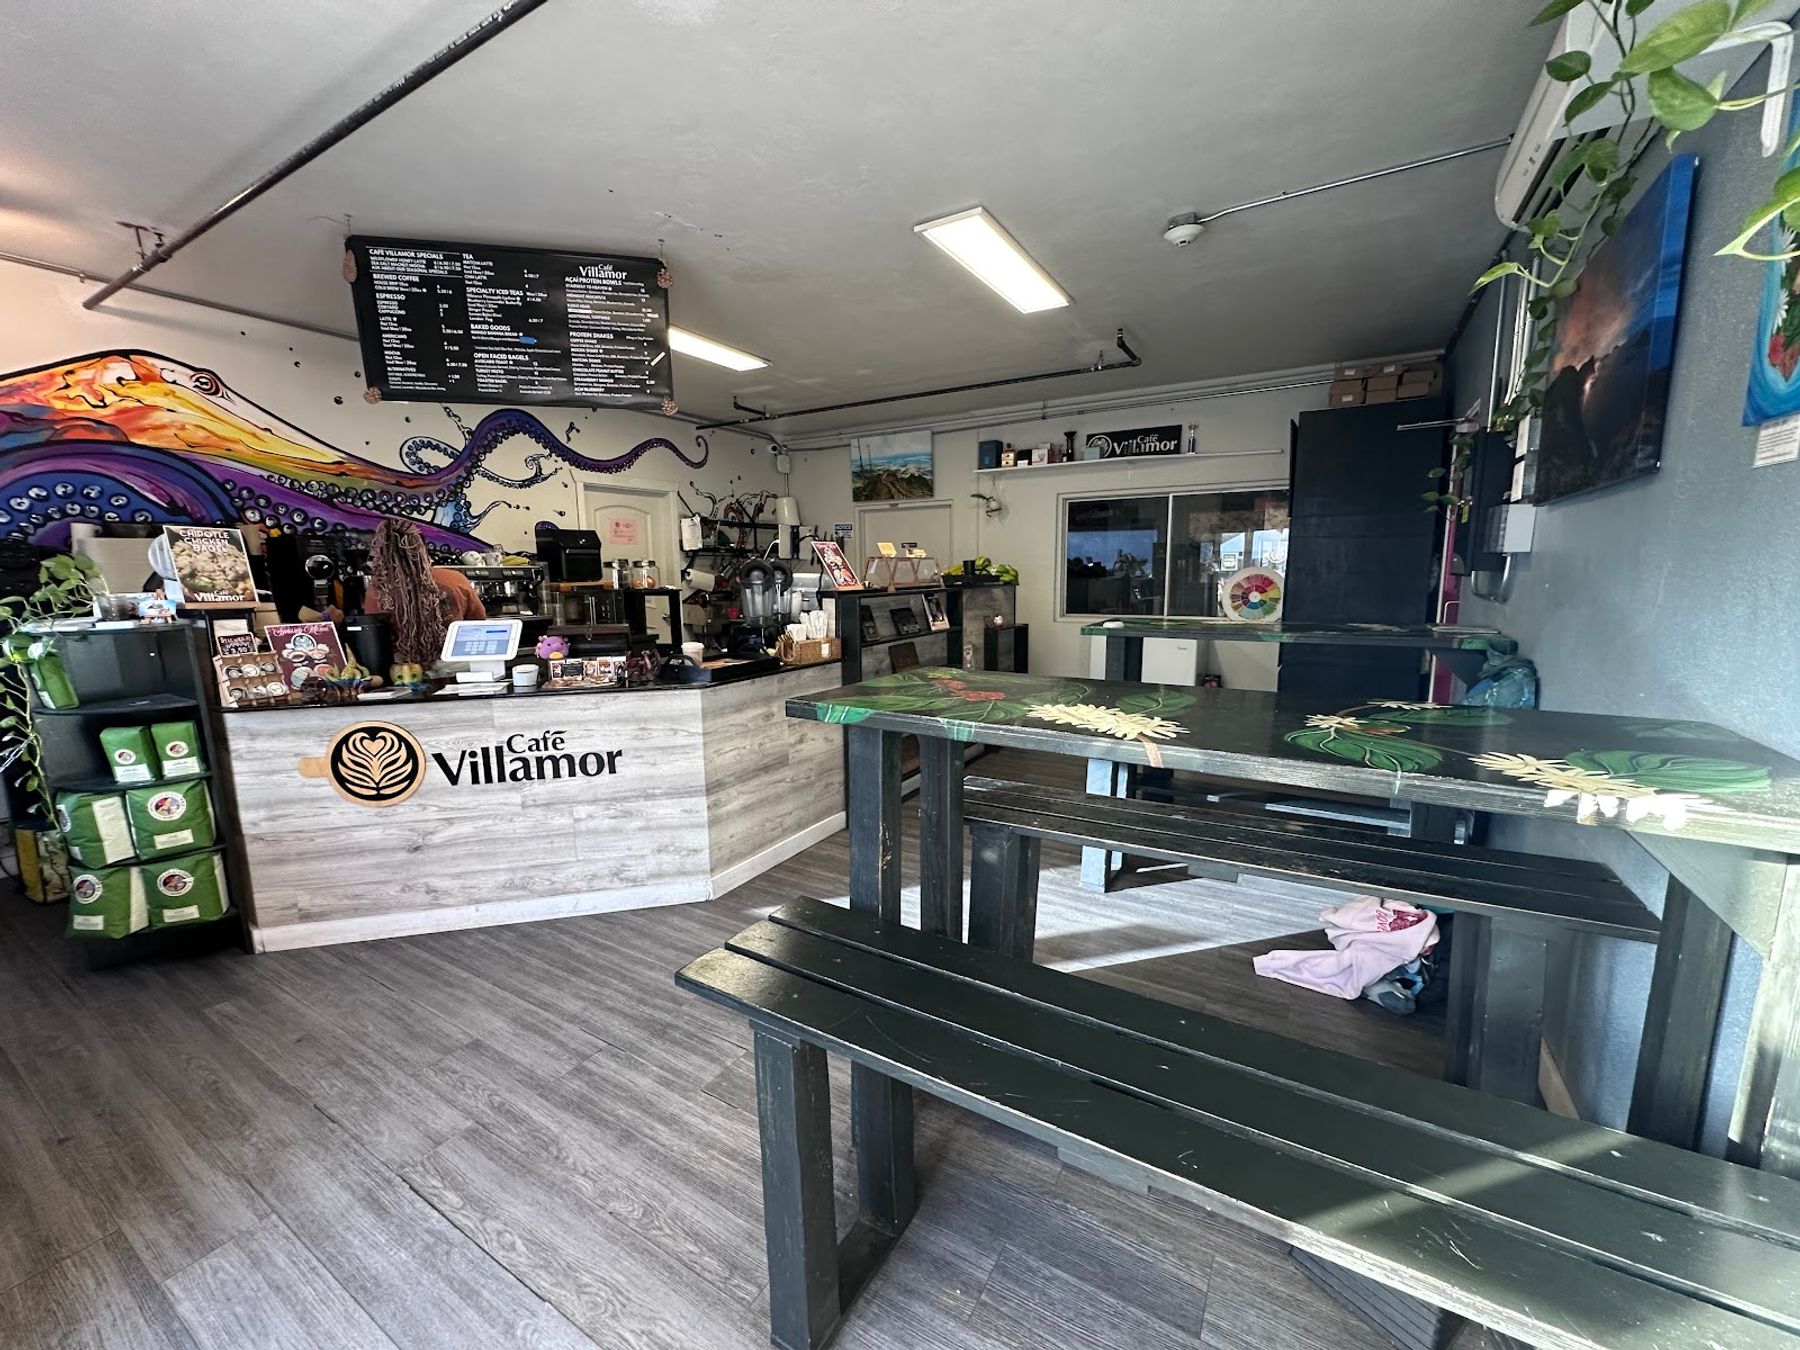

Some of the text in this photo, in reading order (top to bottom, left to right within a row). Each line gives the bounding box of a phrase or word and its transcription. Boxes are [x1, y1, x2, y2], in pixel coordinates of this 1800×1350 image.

[579, 266, 627, 280] Villamor
[1138, 434, 1158, 443] Café
[1113, 439, 1178, 455] Villamor
[179, 530, 229, 538] CHIPOTLE
[184, 537, 228, 545] CHICKEN
[194, 591, 245, 601] Villamor
[506, 729, 567, 754] Café
[432, 746, 622, 786] Villamor
